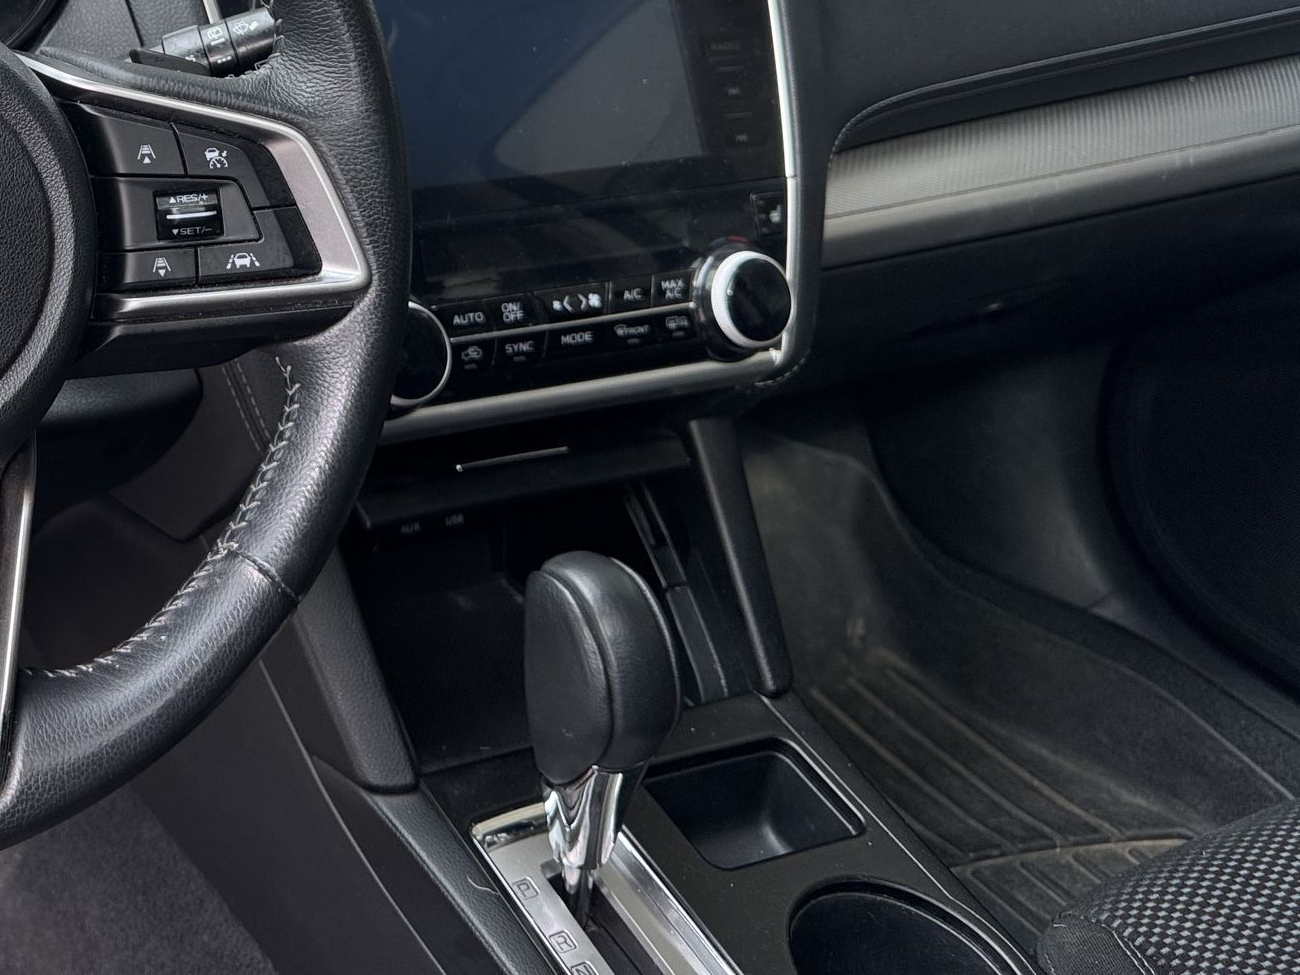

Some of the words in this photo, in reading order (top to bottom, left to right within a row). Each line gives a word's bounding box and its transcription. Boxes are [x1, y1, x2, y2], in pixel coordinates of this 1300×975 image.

[660, 278, 685, 291] MAX
[623, 288, 644, 300] A/C
[453, 311, 484, 325] AUTO
[502, 311, 524, 322] OFF
[560, 330, 594, 346] MODE
[504, 340, 535, 354] SYNC
[516, 882, 530, 898] P
[555, 934, 573, 951] R
